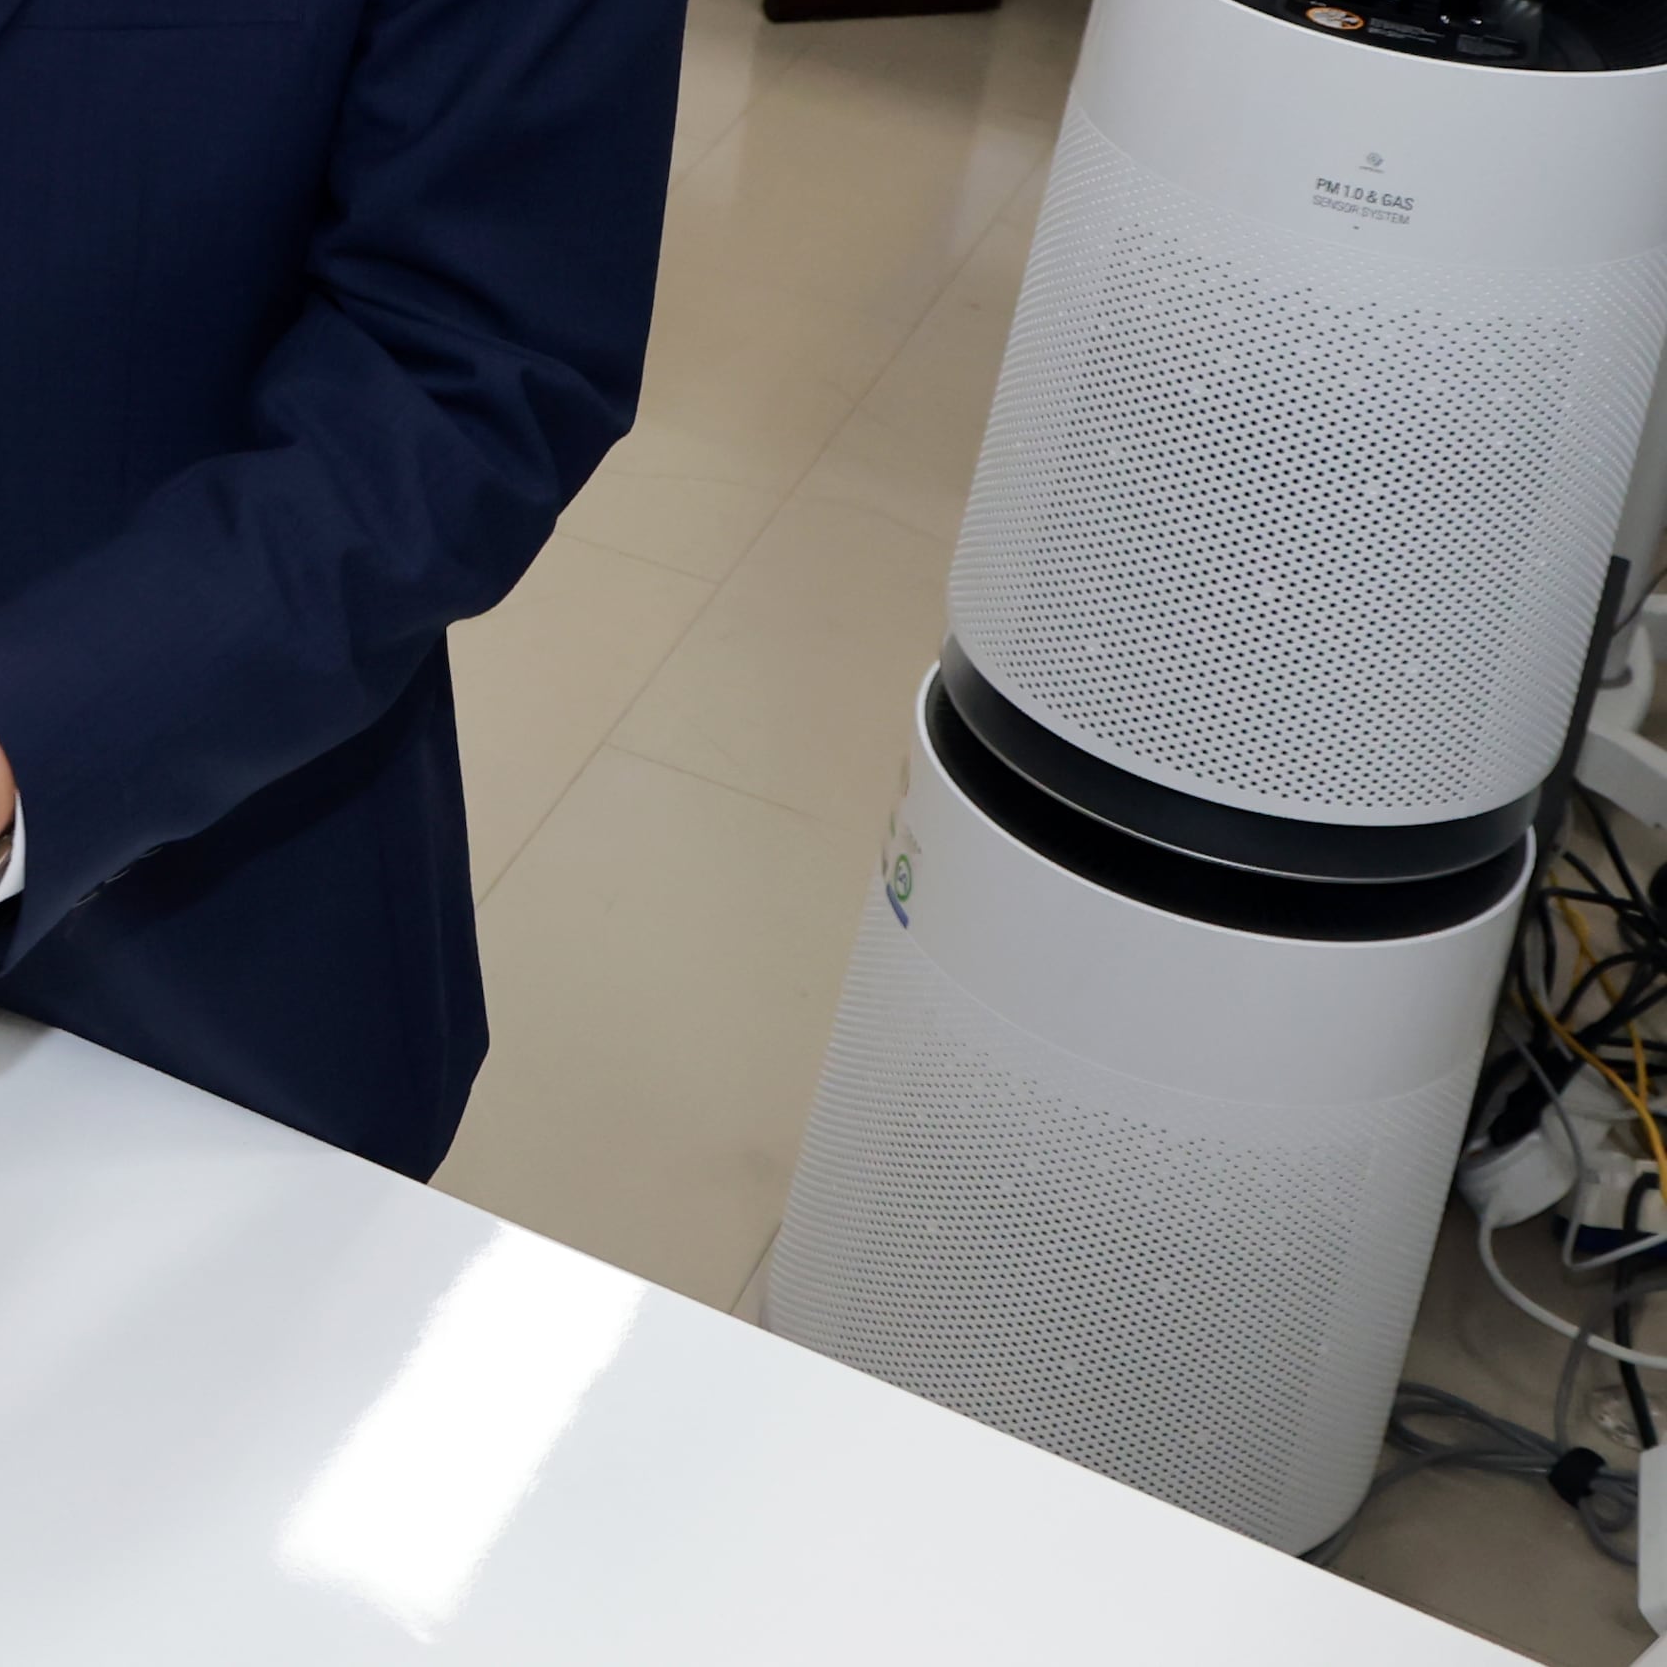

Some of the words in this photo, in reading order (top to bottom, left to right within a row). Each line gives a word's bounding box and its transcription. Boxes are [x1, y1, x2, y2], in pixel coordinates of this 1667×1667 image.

[1366, 190, 1378, 204] &
[1382, 193, 1415, 211] GAS
[1361, 206, 1411, 224] SYSTEM
